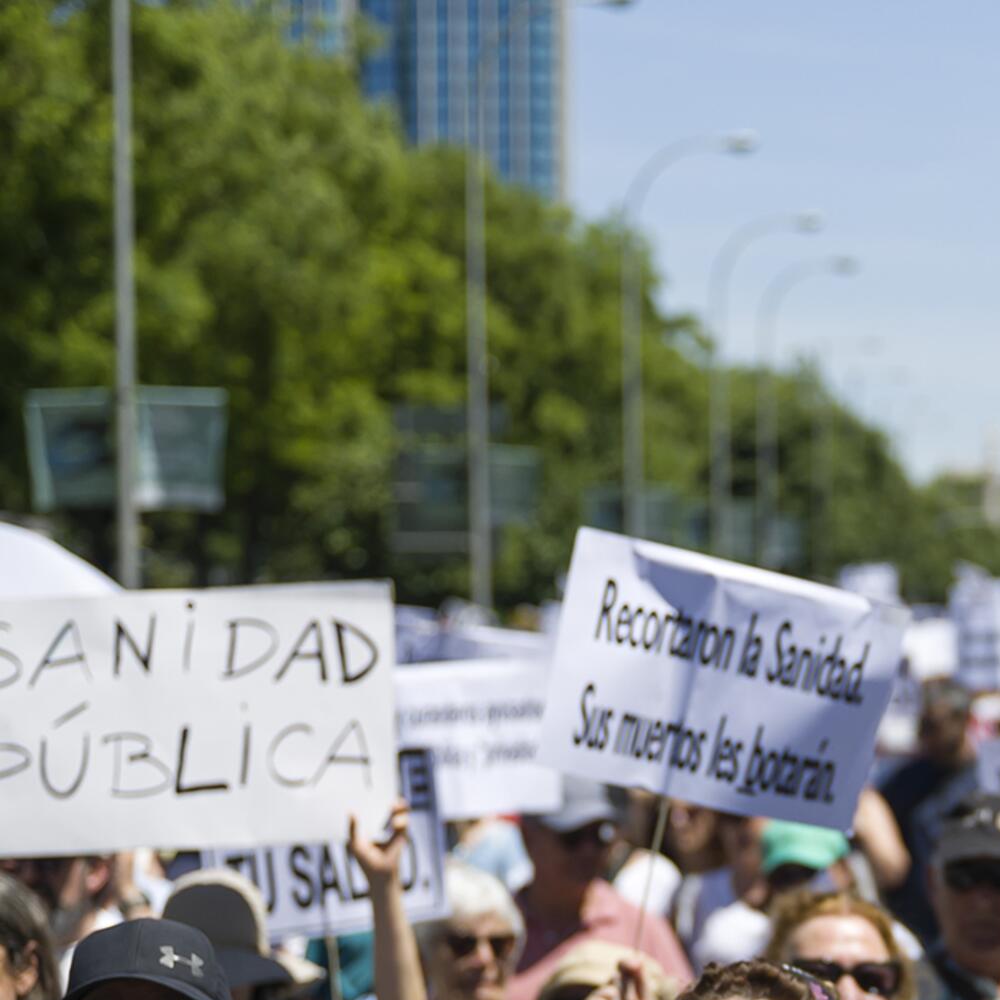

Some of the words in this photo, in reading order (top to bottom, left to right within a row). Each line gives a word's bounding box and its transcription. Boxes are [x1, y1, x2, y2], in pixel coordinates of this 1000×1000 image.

[594, 577, 736, 675] Recortaron
[739, 612, 761, 678] la
[767, 620, 870, 705] Sanidad.
[573, 683, 613, 751] Sus
[620, 712, 706, 774] muertos
[708, 719, 743, 783] les
